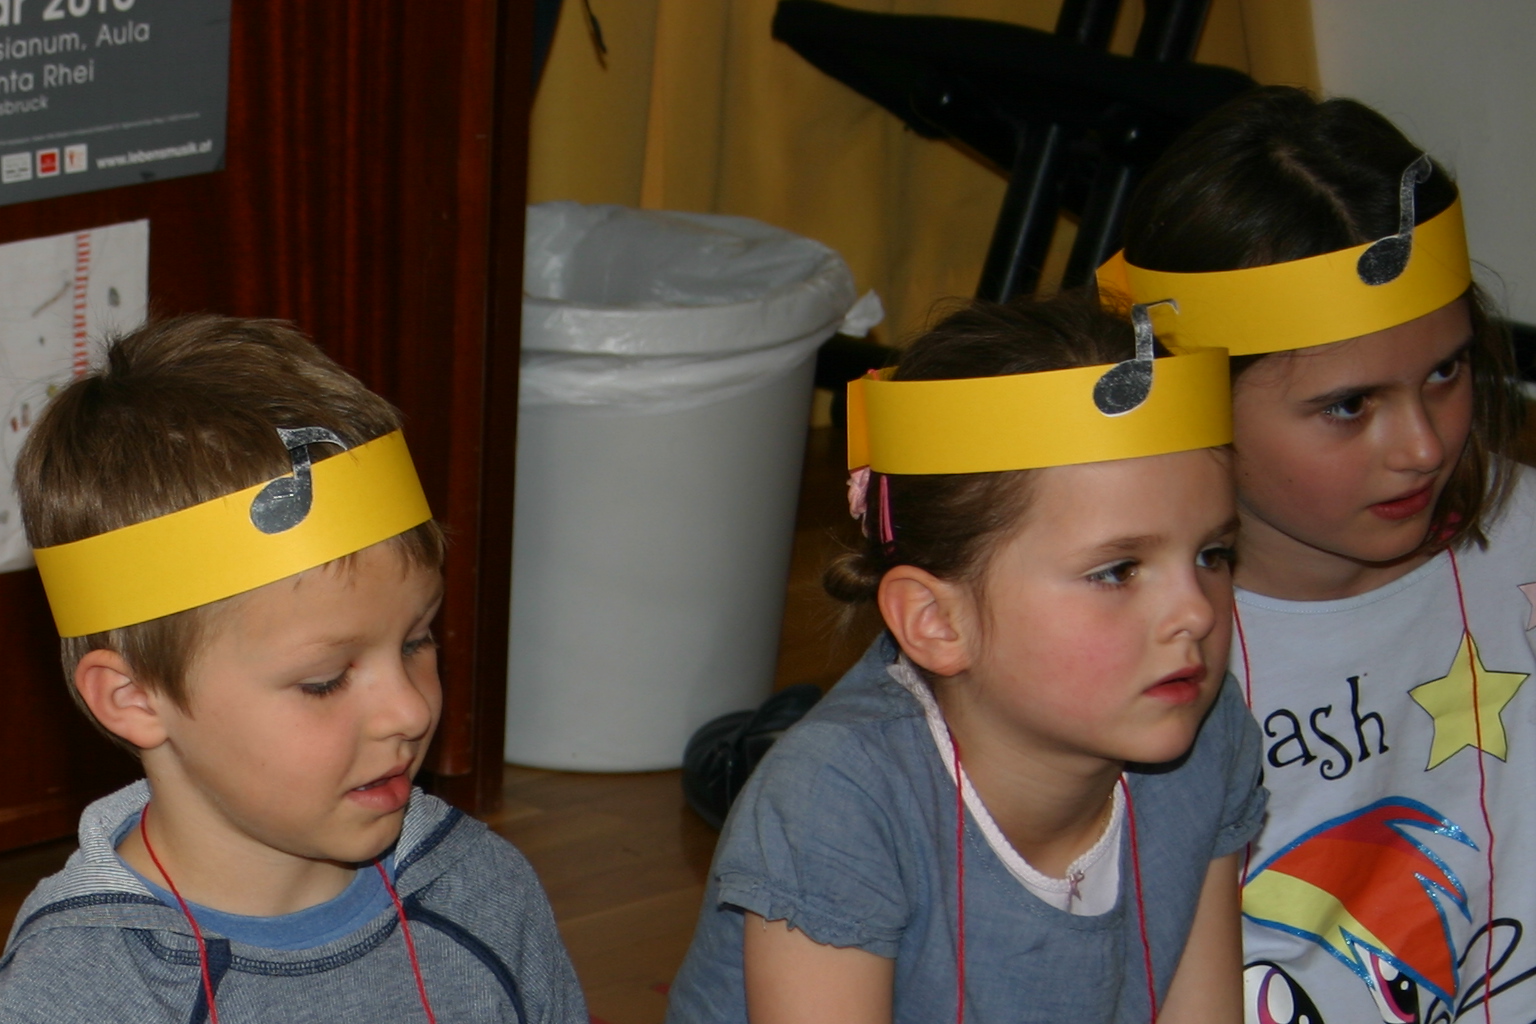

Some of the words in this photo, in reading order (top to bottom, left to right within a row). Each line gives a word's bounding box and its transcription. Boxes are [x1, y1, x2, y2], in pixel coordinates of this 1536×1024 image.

[95, 20, 151, 48] Aula
[43, 60, 95, 88] Rhei
[1259, 673, 1389, 781] ash
